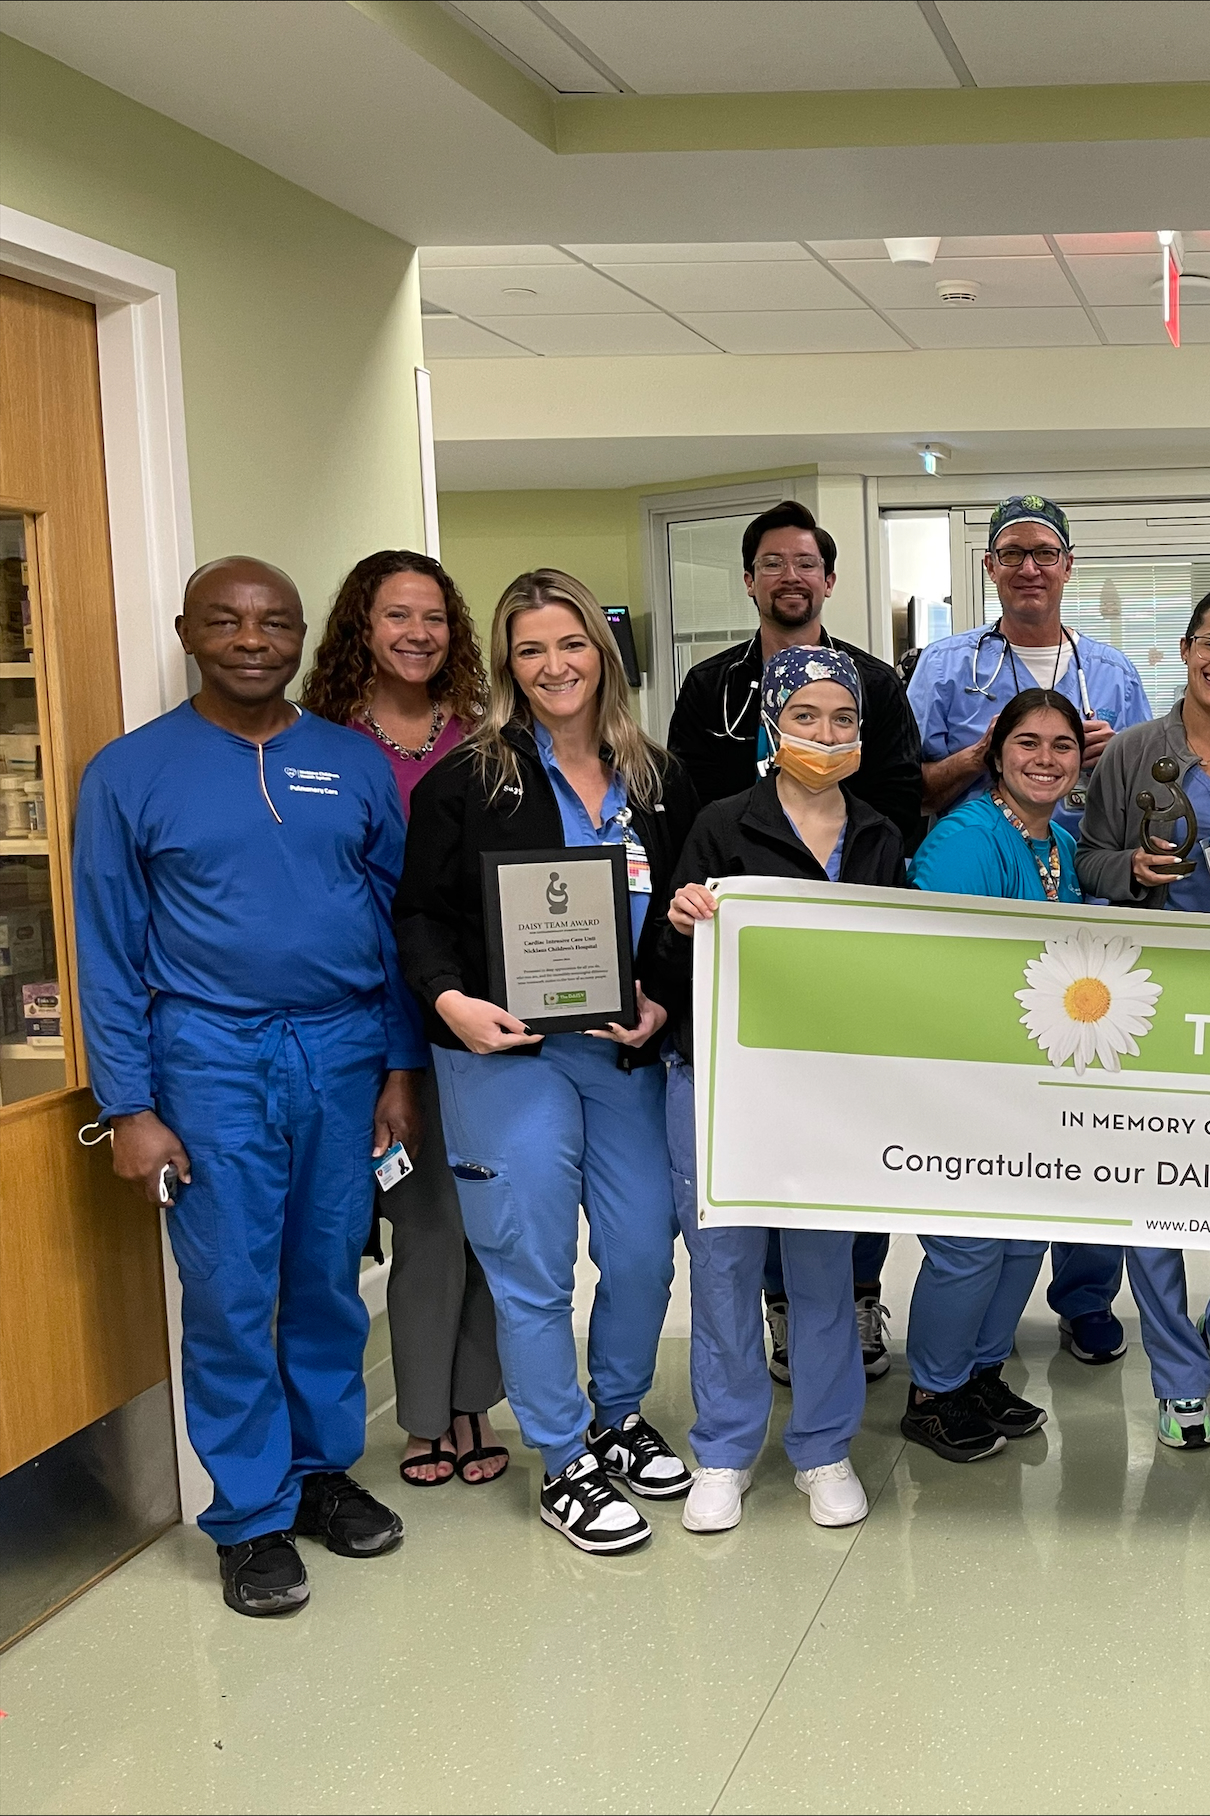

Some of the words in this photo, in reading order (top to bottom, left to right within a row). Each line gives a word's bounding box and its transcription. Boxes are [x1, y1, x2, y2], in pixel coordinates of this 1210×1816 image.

[518, 922, 542, 931] DAISY
[544, 920, 568, 929] TEAM
[570, 918, 600, 927] AWARD
[1062, 1110, 1084, 1128] IN
[1093, 1113, 1196, 1135] MEMORY
[882, 1144, 1082, 1181] Congratulate
[1094, 1165, 1146, 1184] our
